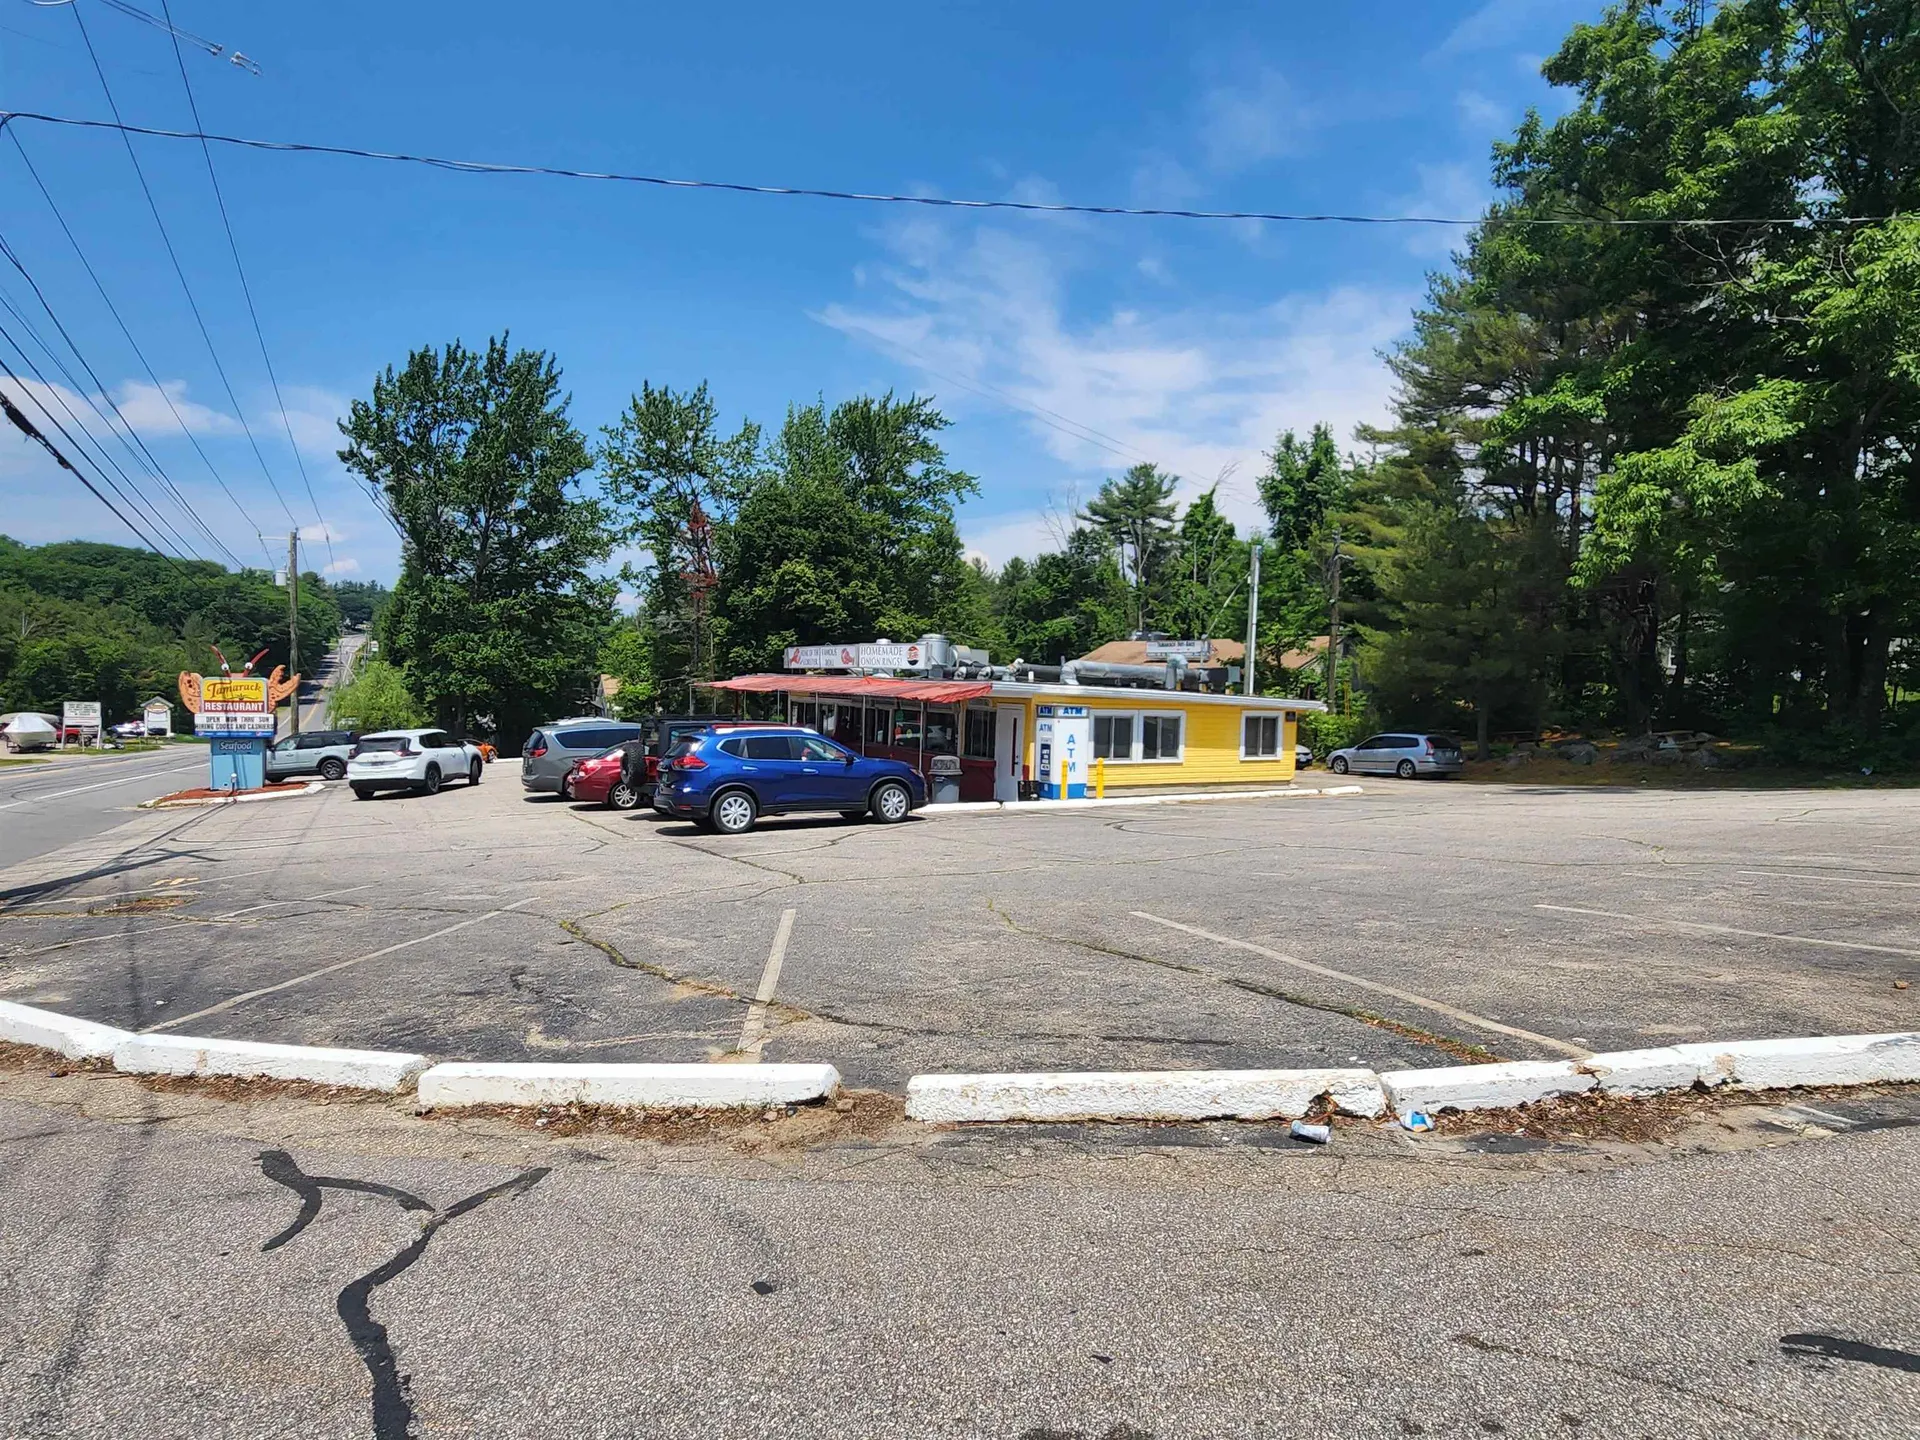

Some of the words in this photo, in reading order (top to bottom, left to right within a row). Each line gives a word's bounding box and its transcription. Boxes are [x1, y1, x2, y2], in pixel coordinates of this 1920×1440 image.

[860, 646, 903, 656] HOMEMADE
[860, 656, 880, 666] ONION
[206, 681, 262, 699] Tamarack
[205, 702, 264, 711] RESTAURANT
[1040, 706, 1052, 714] ATM
[1062, 706, 1083, 715] ATM
[1039, 723, 1052, 732] ATM
[220, 741, 252, 752] Seafood
[1067, 733, 1076, 772] ATM
